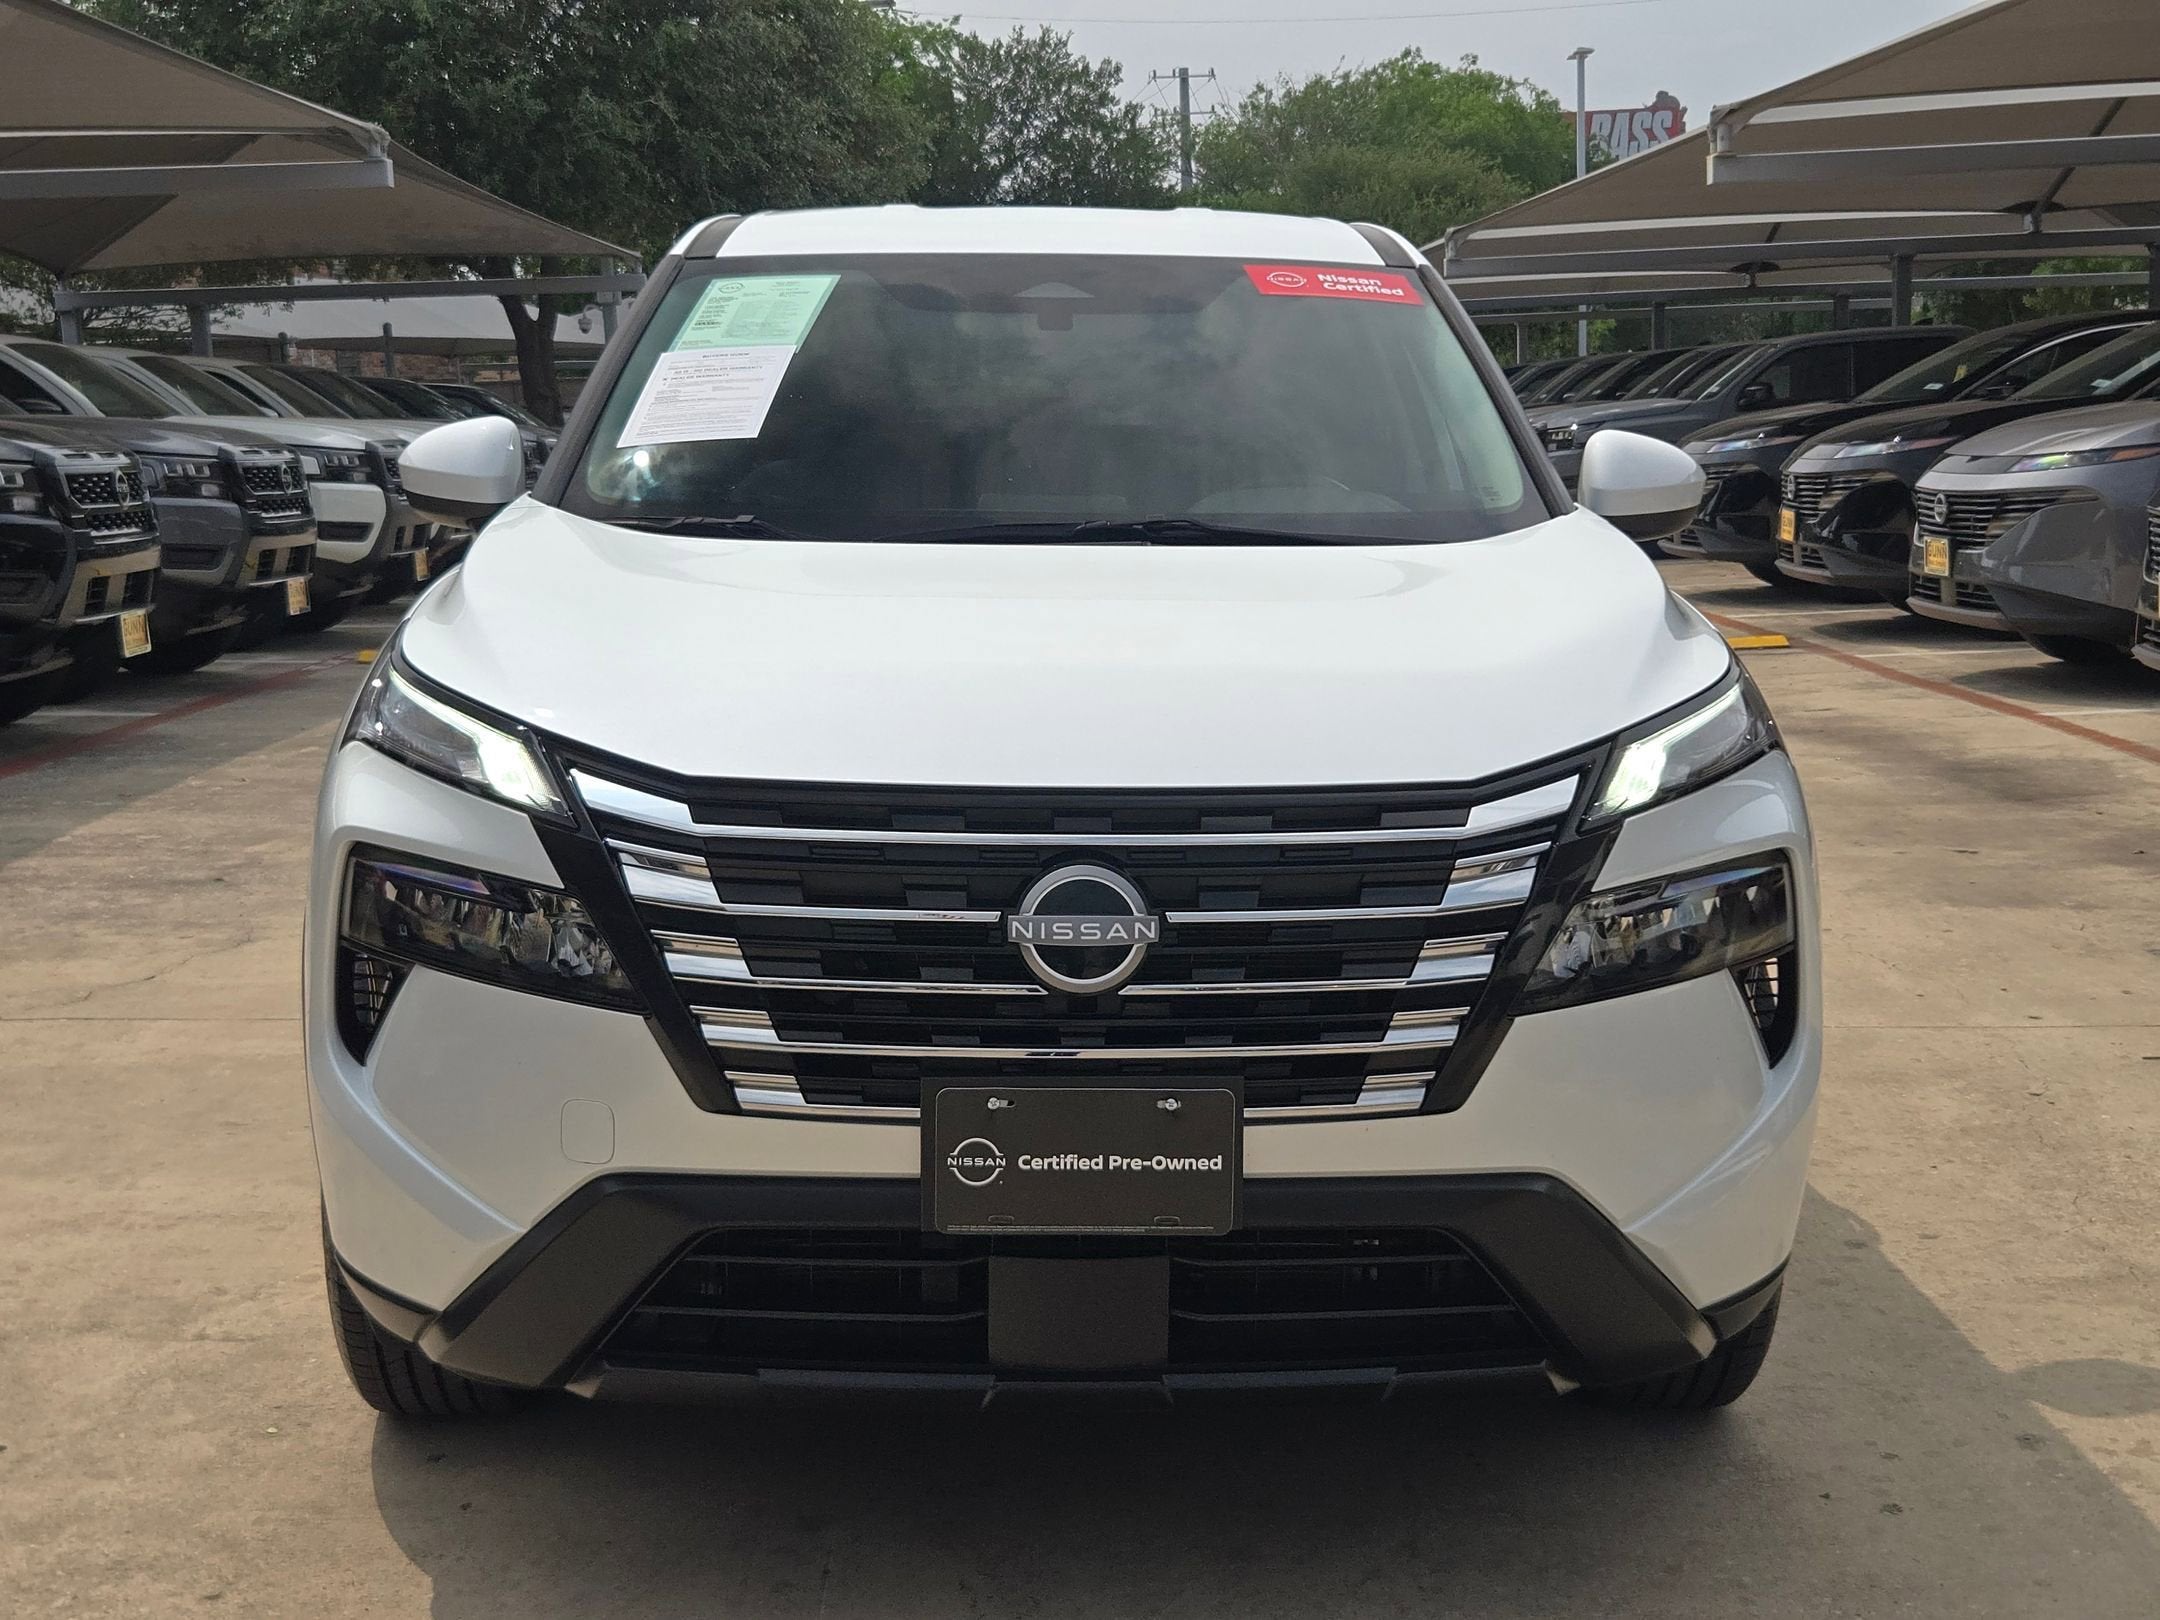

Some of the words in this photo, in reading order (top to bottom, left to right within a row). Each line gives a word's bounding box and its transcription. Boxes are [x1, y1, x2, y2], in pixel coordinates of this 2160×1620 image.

[1590, 110, 1672, 160] BASS
[1317, 273, 1381, 286] Nissan
[1323, 282, 1404, 296] Certified
[1011, 921, 1156, 940] NISSAN
[947, 1157, 1006, 1167] NISSAN
[1018, 1154, 1103, 1171] Certified
[1109, 1154, 1222, 1171] Pre-Owned
